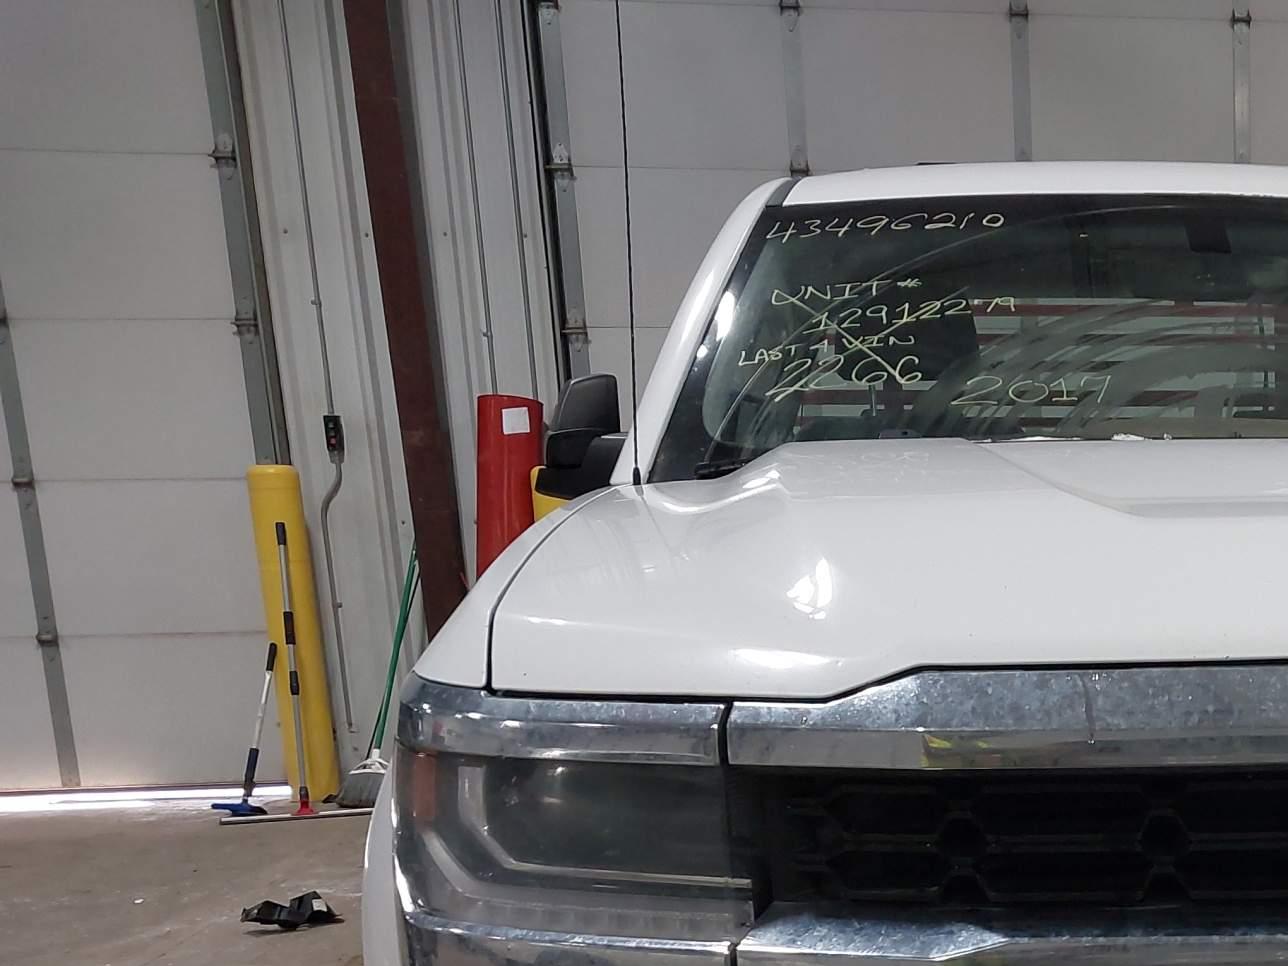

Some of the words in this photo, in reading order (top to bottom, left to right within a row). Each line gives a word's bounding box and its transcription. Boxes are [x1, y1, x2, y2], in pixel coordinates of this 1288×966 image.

[766, 213, 1004, 244] 43496210
[772, 279, 892, 305] UNIT
[951, 375, 1112, 405] 2017
